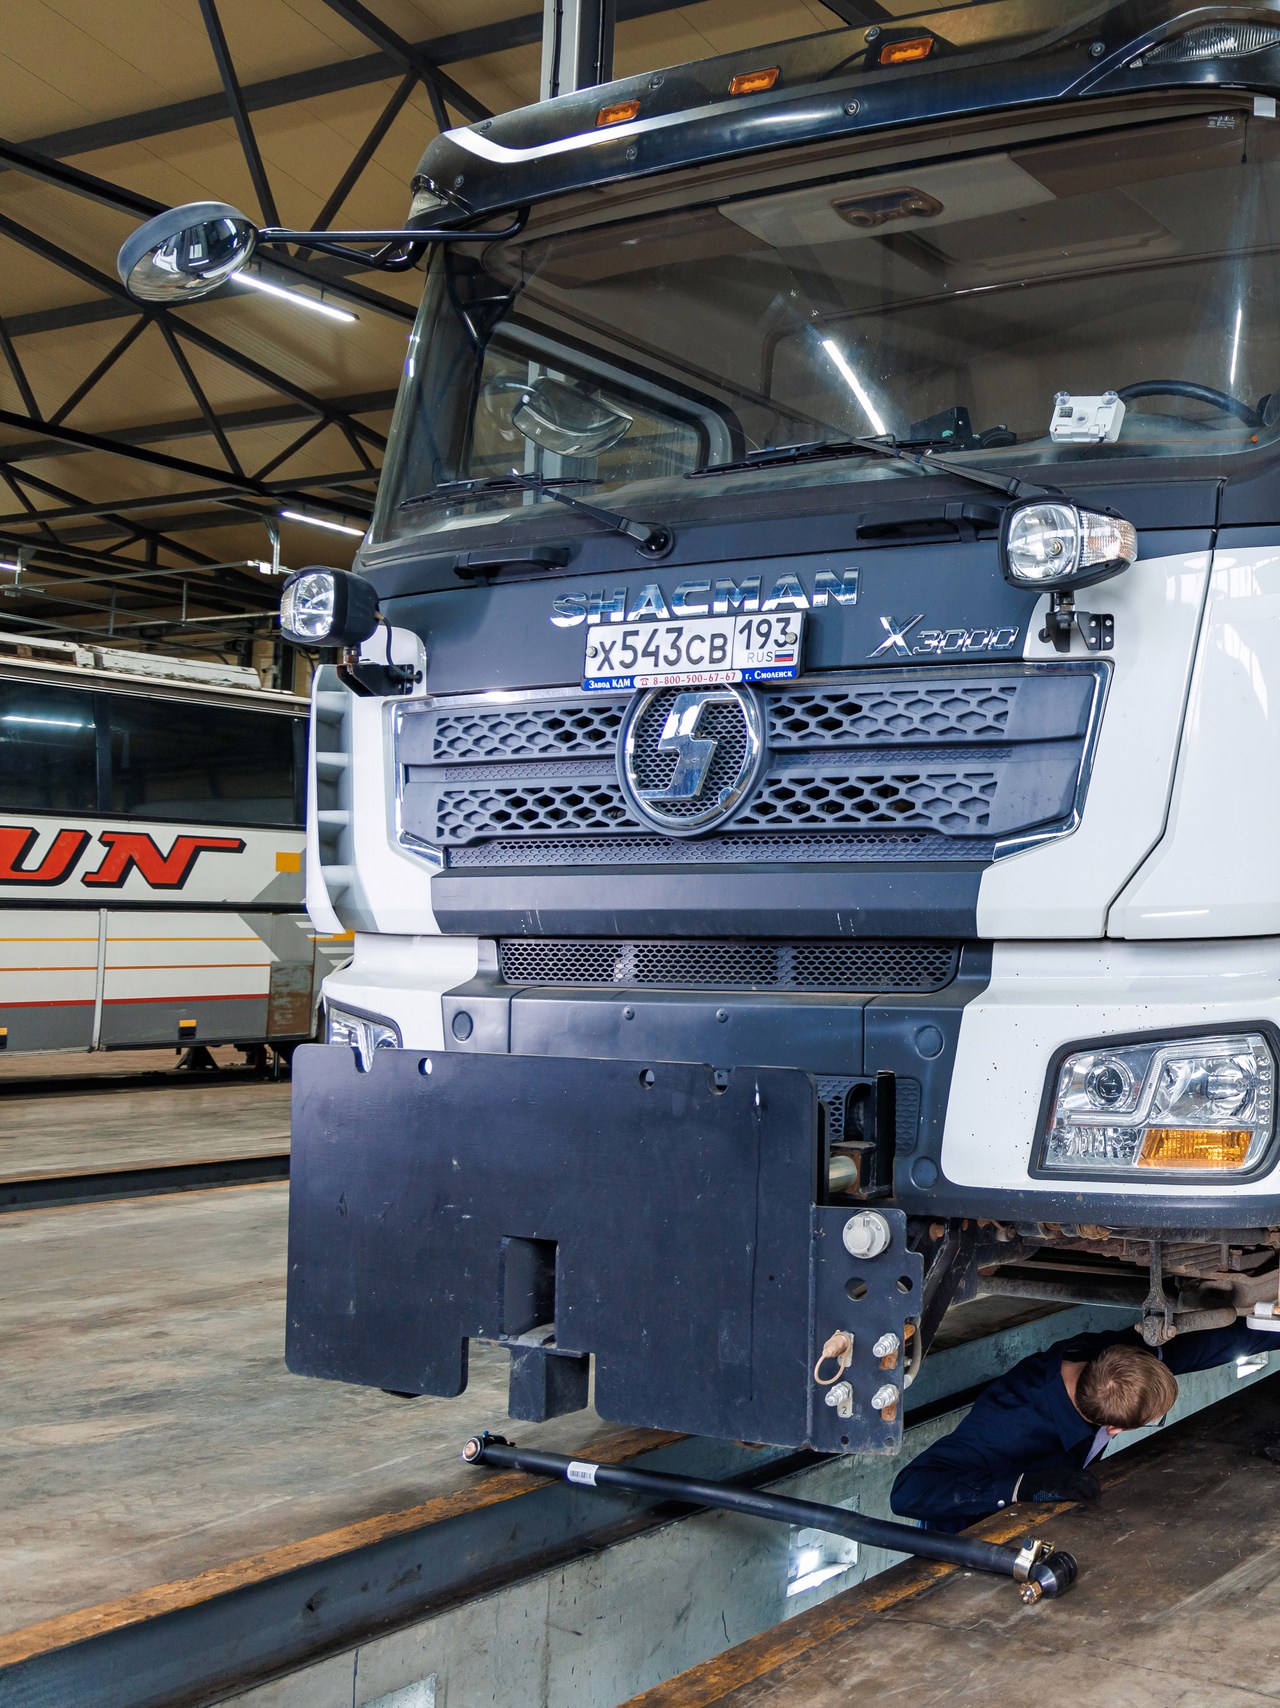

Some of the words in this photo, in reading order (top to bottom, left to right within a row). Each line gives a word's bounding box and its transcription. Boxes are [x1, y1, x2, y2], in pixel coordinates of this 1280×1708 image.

[550, 566, 860, 628] SHACMAN
[738, 617, 792, 650] 193
[866, 614, 1019, 658] X3000
[747, 651, 773, 663] RUS
[653, 672, 736, 685] 8-800-500-67-67
[842, 1406, 848, 1415] 2
